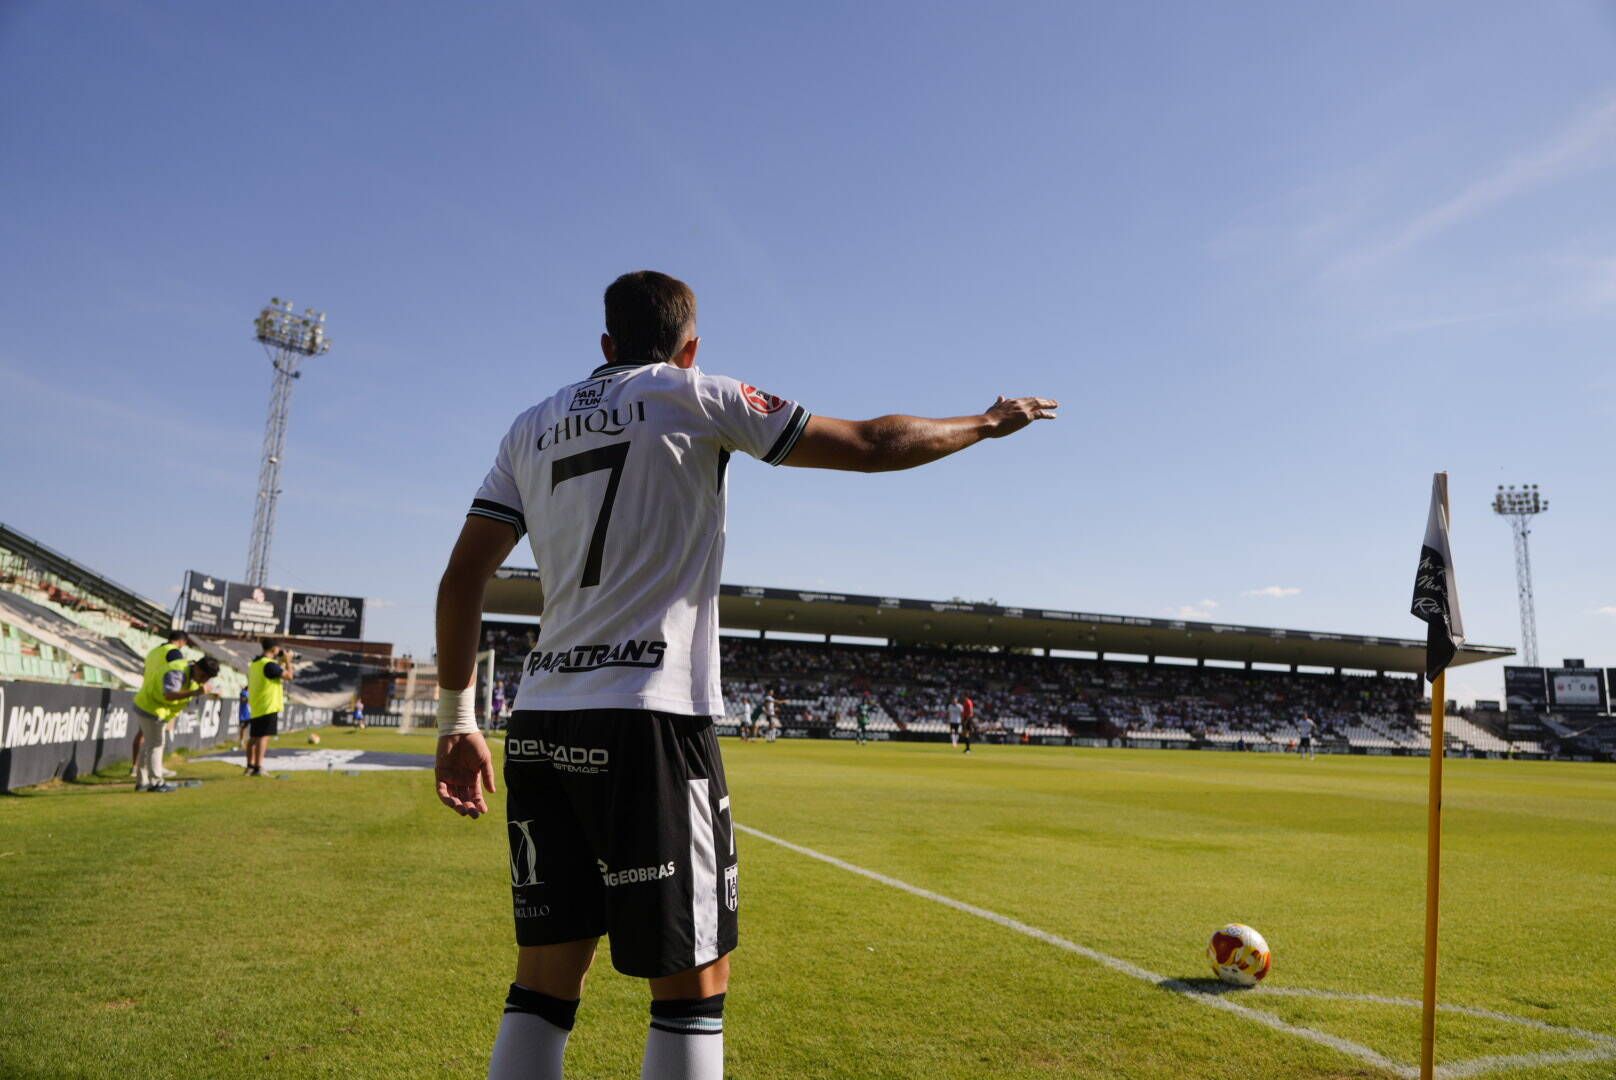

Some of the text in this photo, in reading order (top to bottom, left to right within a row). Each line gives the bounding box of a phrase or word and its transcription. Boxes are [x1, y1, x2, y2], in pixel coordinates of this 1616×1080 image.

[573, 390, 596, 400] PAR
[578, 397, 602, 407] TUN
[536, 401, 646, 452] CHIQUI
[551, 440, 632, 589] 7
[553, 761, 599, 774] ISTEMAS
